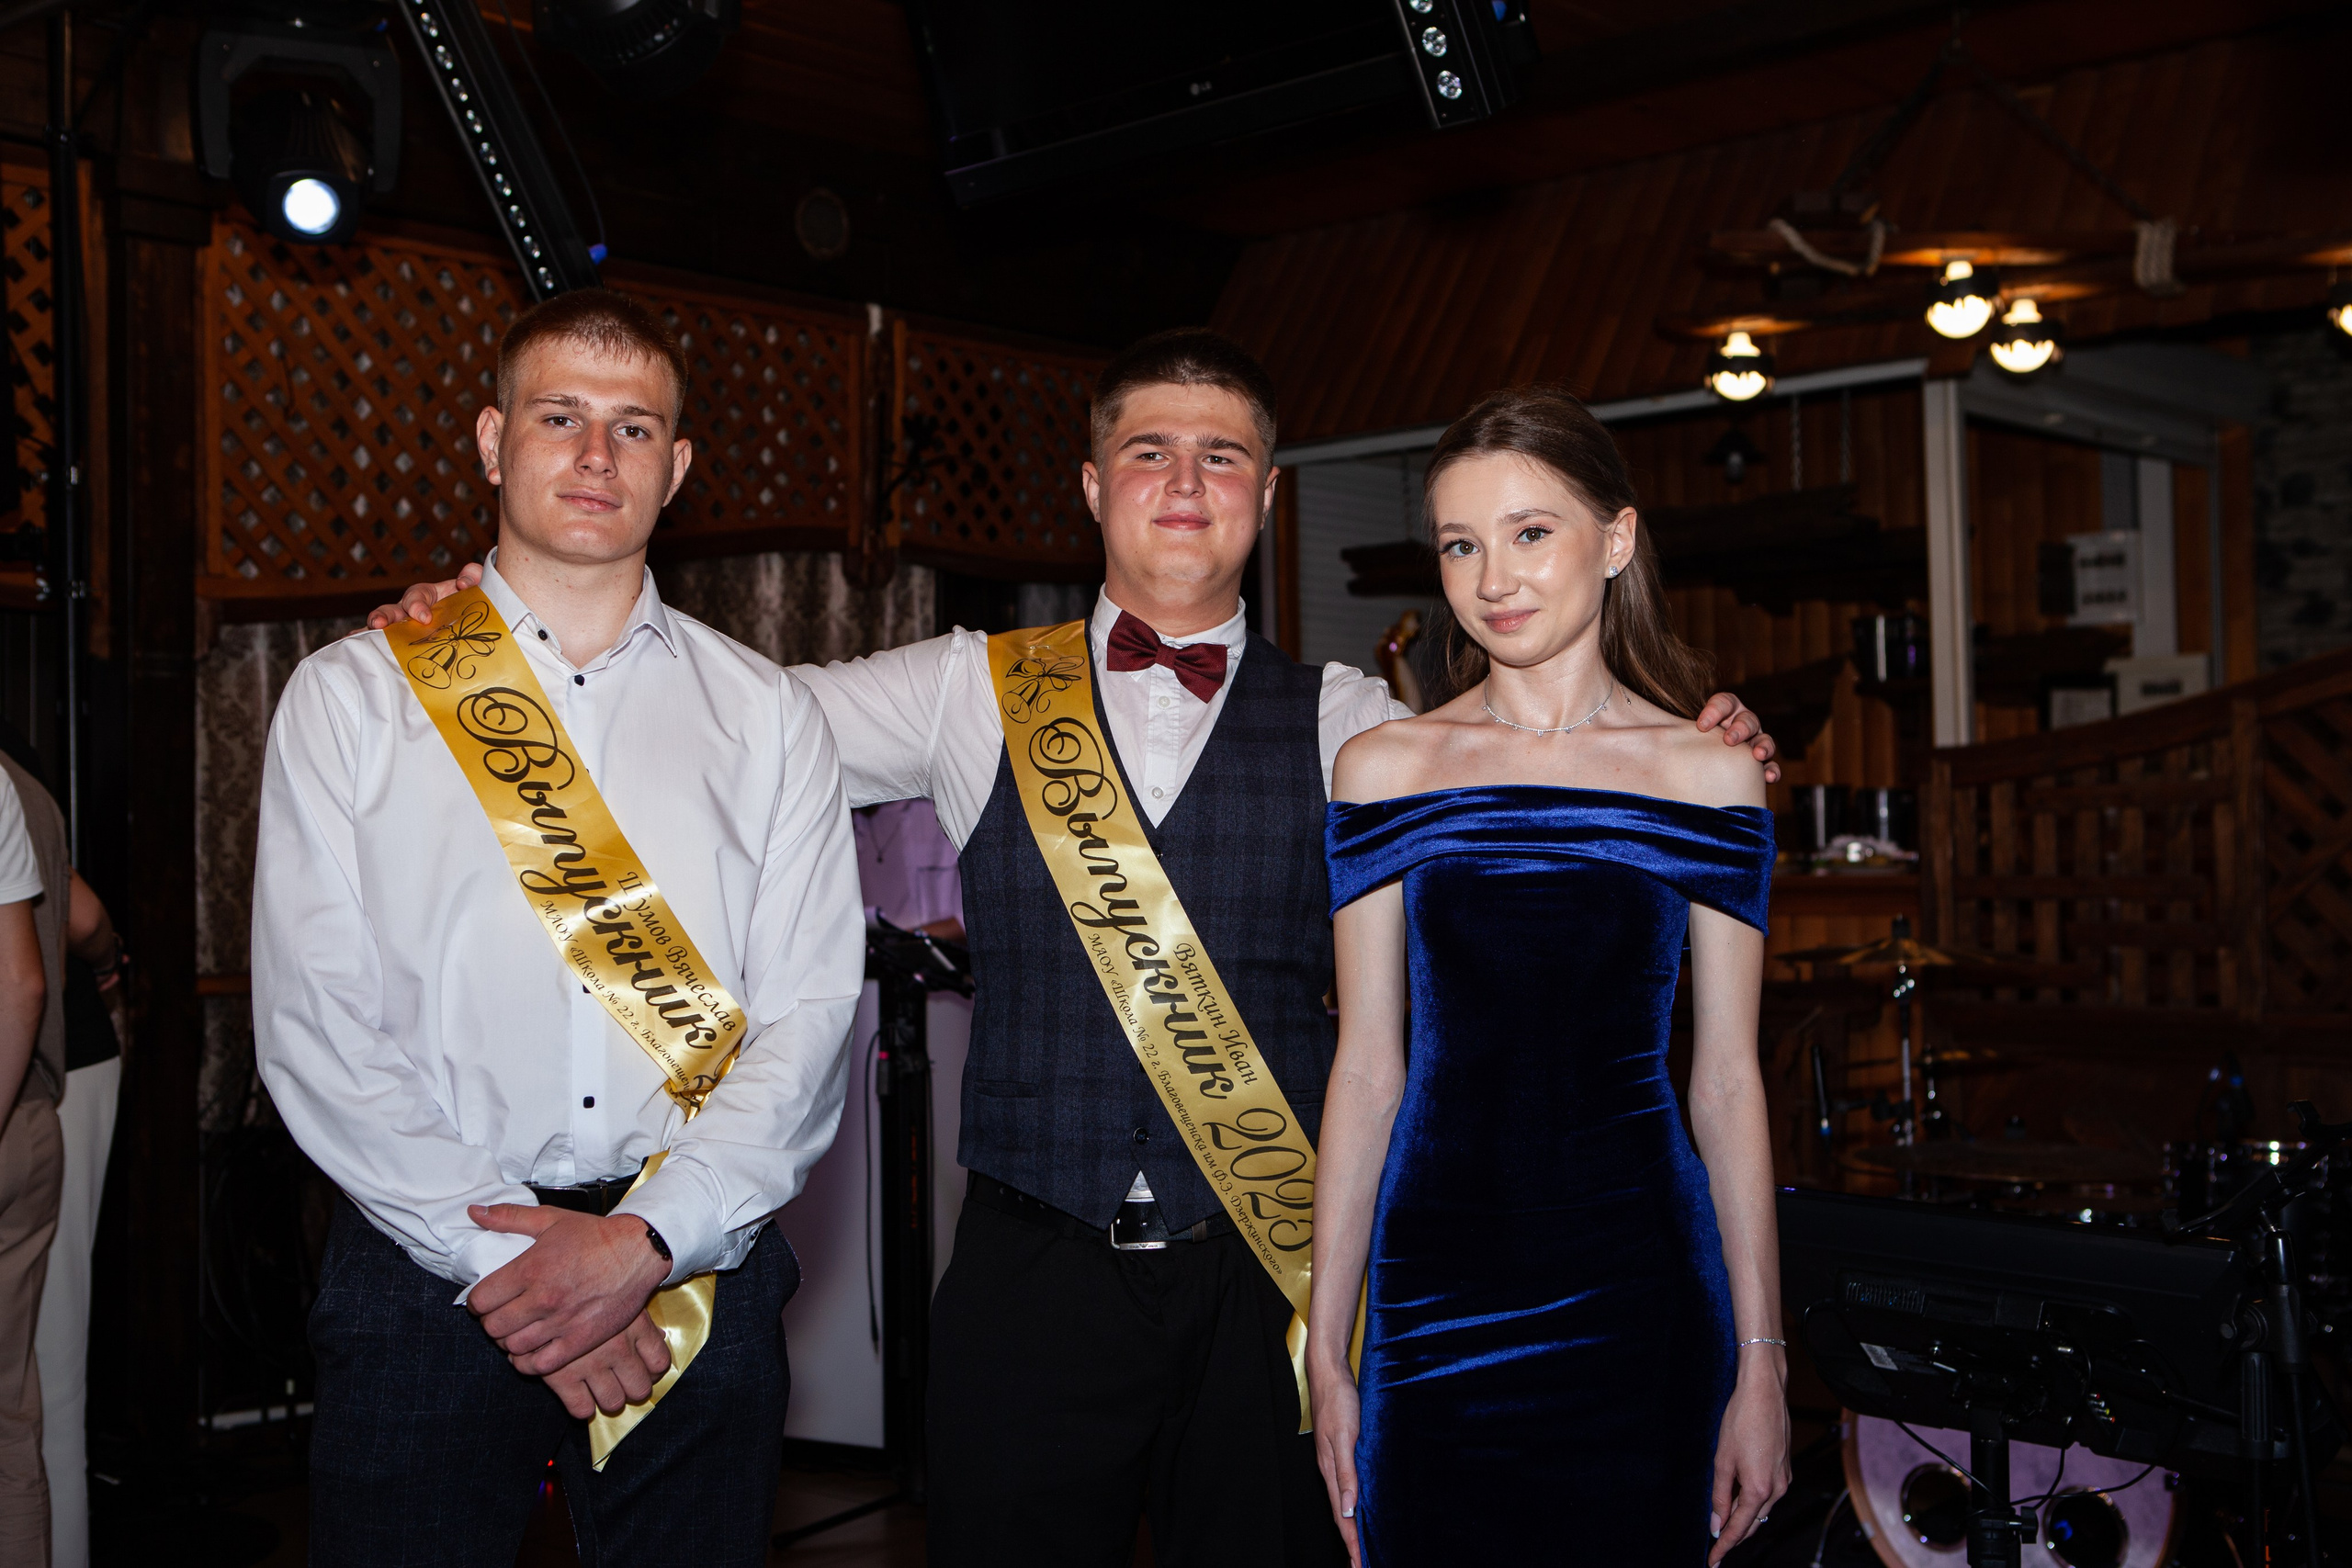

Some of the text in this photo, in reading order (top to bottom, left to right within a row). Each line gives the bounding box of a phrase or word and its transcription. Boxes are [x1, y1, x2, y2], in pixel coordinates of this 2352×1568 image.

[457, 686, 718, 1050] Выпускник
[540, 900, 579, 942] МАОУ
[571, 947, 605, 989] «Школа
[604, 990, 618, 1005] №
[616, 1007, 634, 1020] 22
[630, 1021, 639, 1030] г.
[616, 872, 672, 945] Шумов
[663, 946, 736, 1032] Вячеслав
[1028, 716, 1315, 1253] Выпускник 2025
[1088, 934, 1283, 1274] МАОУ «Школа № 22 г. Благовещенска им Ф.Э. Дзержинского»
[1173, 943, 1258, 1086] Вяткин Иван
